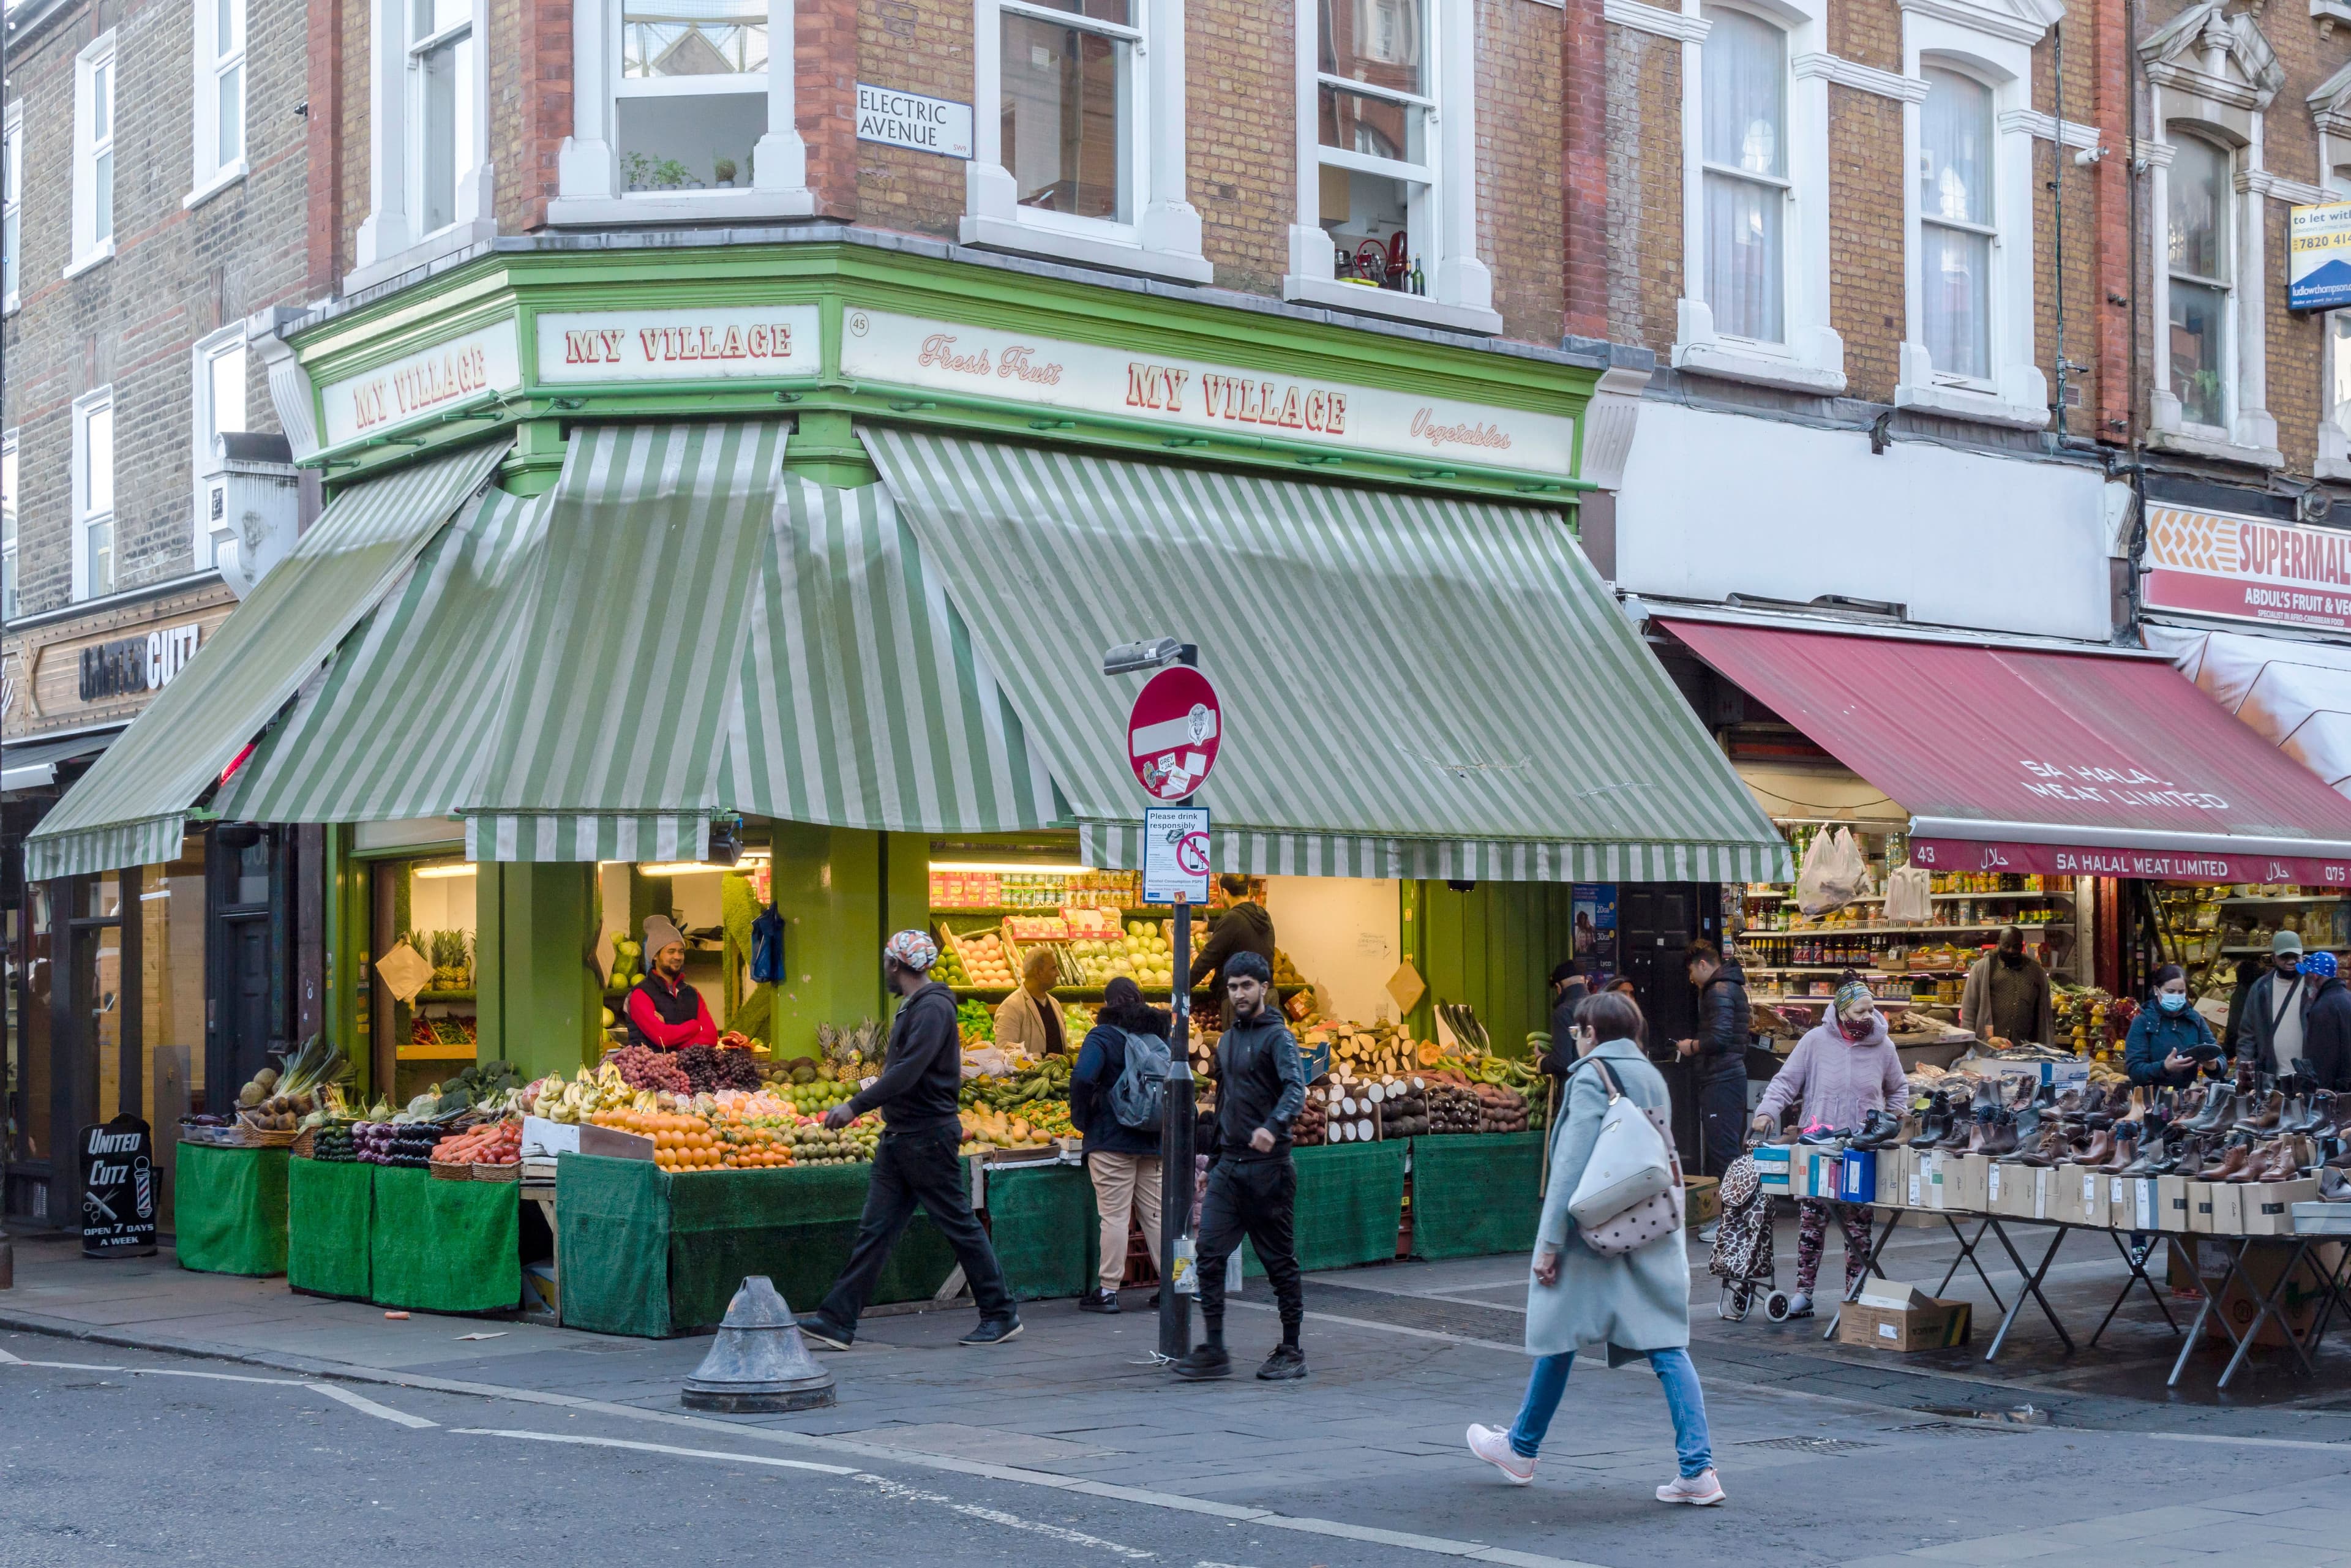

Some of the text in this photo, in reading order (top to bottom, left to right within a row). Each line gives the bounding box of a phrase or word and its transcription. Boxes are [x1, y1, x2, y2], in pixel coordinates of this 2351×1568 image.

[860, 89, 947, 125] ELECTRIC
[859, 115, 938, 147] AVENUE
[953, 144, 967, 152] SW9
[2310, 214, 2325, 223] let
[2300, 236, 2329, 249] 7820
[853, 318, 866, 329] 45
[566, 323, 792, 364] MY VILLAGE
[918, 334, 1063, 385] Fresh Fruit
[353, 341, 487, 430] MY VILLAGE
[1126, 362, 1347, 435] MY VILLAGE
[1411, 408, 1511, 449] Vegetables
[2239, 523, 2351, 586] SUPERMAL
[2244, 587, 2290, 609] ABDUL'S
[2292, 593, 2323, 612] FRUIT
[2325, 598, 2334, 613] &
[2331, 617, 2344, 626] FOOD
[1160, 755, 1174, 765] GREY
[2019, 760, 2074, 780] SA
[2020, 782, 2229, 809] MEAT LIMITED
[1917, 846, 1935, 863] 43
[1981, 847, 2009, 869] حلال
[2057, 853, 2229, 876] SA HALAL MEAT LIMITED
[2266, 861, 2290, 882] حلال
[2325, 866, 2345, 882] 075
[88, 1128, 141, 1154] UNITED
[89, 1160, 129, 1185] CUTZ
[84, 1223, 154, 1236] OPEN 7 DAYS
[111, 1236, 139, 1245] WEEK
